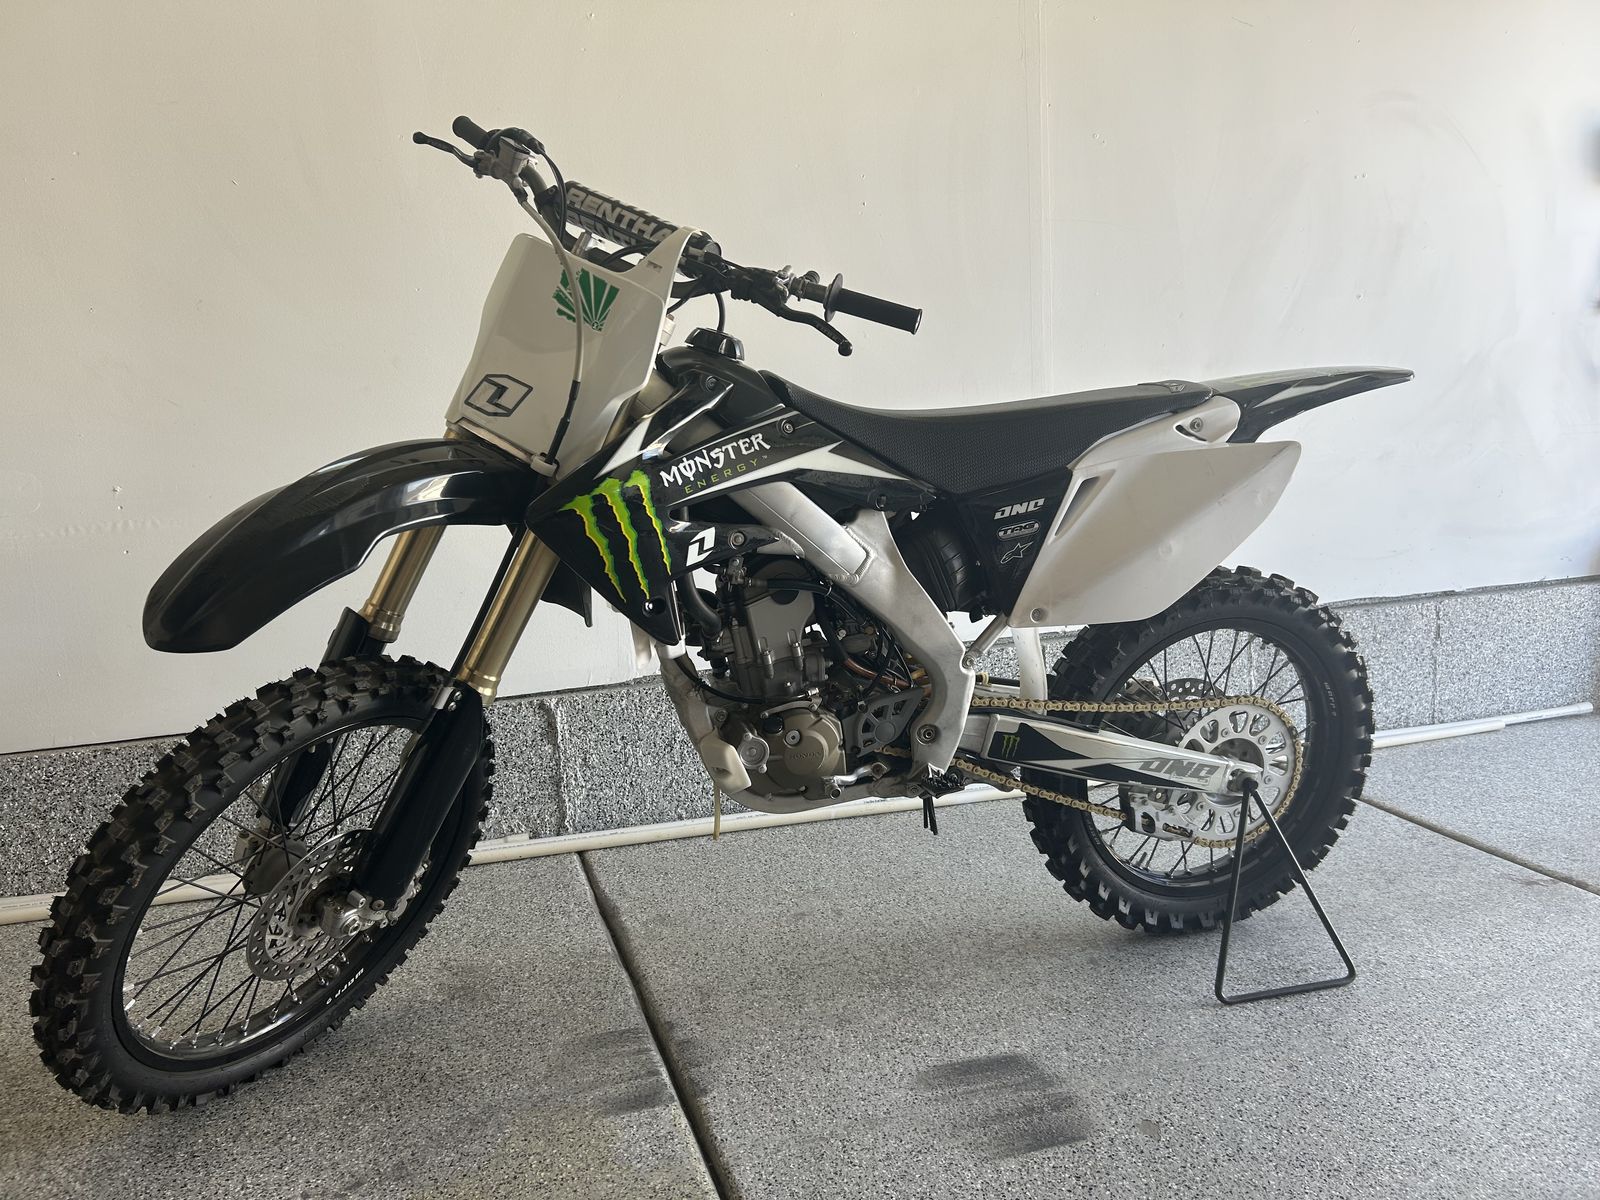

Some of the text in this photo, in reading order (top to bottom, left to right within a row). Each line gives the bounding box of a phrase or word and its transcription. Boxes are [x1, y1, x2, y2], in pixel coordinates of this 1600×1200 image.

[565, 187, 676, 243] RENTHA
[659, 433, 771, 487] MONSTER
[684, 459, 757, 494] ENERGY
